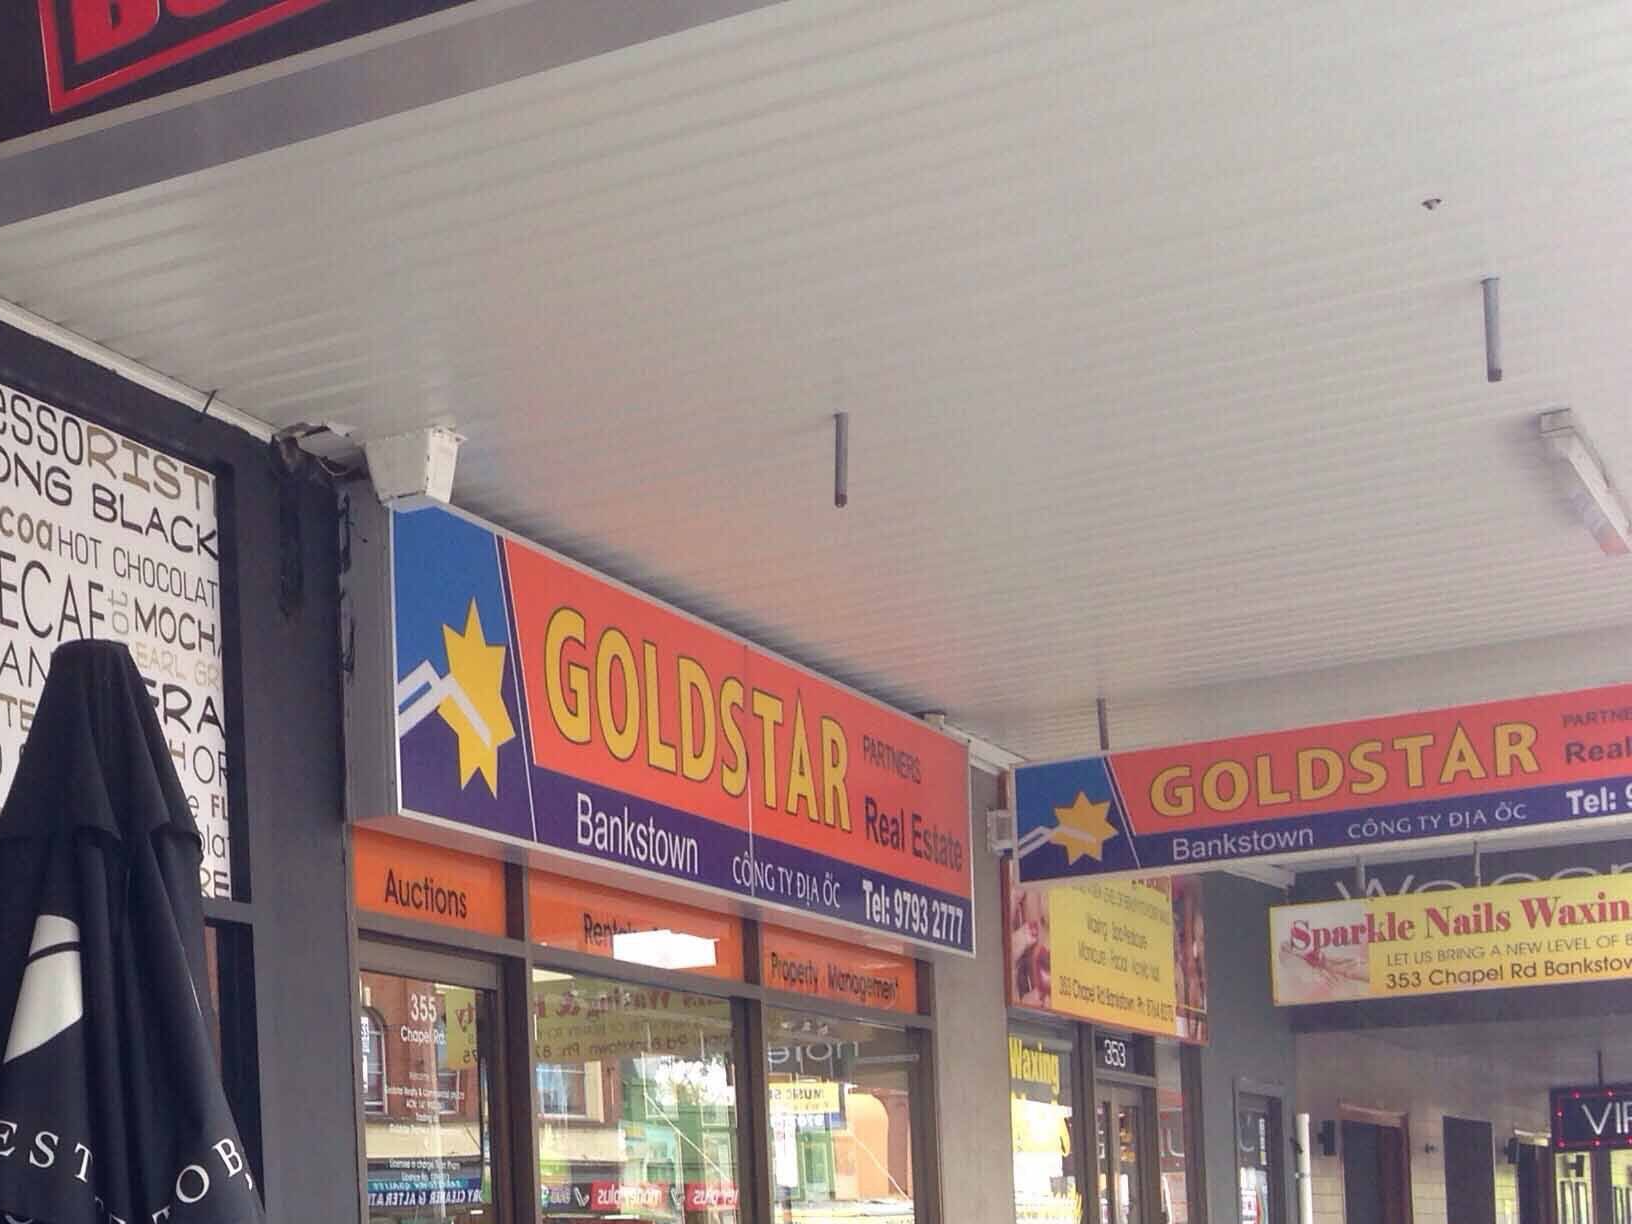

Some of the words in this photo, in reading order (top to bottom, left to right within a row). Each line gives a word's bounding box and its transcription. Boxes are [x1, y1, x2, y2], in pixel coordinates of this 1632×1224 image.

[58, 526, 102, 569] HOT
[92, 484, 219, 561] BLACK
[134, 597, 223, 657] MOCH
[135, 643, 187, 681] EARL
[543, 606, 853, 833] GOLDSTAR
[863, 735, 922, 785] PARTNERS
[1150, 720, 1542, 817] GOLDSTAR
[1566, 737, 1632, 765] Real
[864, 796, 905, 853] Real
[911, 813, 963, 872] Estate
[1172, 827, 1314, 861] Bankstown
[1347, 816, 1412, 839] CÔNG
[1417, 813, 1441, 832] TY
[1566, 787, 1617, 816] Tel:
[384, 868, 468, 919] Auctions
[576, 792, 699, 876] Bankstown
[778, 867, 793, 897] TY
[862, 879, 891, 925] Tel:
[894, 888, 928, 936] 9793
[932, 901, 964, 945] 2777
[1291, 912, 1416, 951] Sparkle
[1424, 901, 1512, 939] Nails
[1387, 951, 1409, 967] LET
[1413, 949, 1434, 965] US
[1437, 943, 1486, 962] BRING
[1490, 941, 1503, 956] A
[1506, 939, 1543, 955] NEW
[1546, 936, 1589, 953] LEVEL
[1596, 934, 1620, 949] OF
[771, 951, 818, 993] Property
[827, 961, 899, 1000] Management
[1386, 970, 1422, 990] 353
[1428, 962, 1504, 987] Chapel
[1512, 960, 1537, 979] Rd
[411, 993, 437, 1023] 355
[400, 1025, 432, 1044] Chapel
[1103, 1039, 1127, 1068] 353
[1008, 1031, 1060, 1095] Waxing
